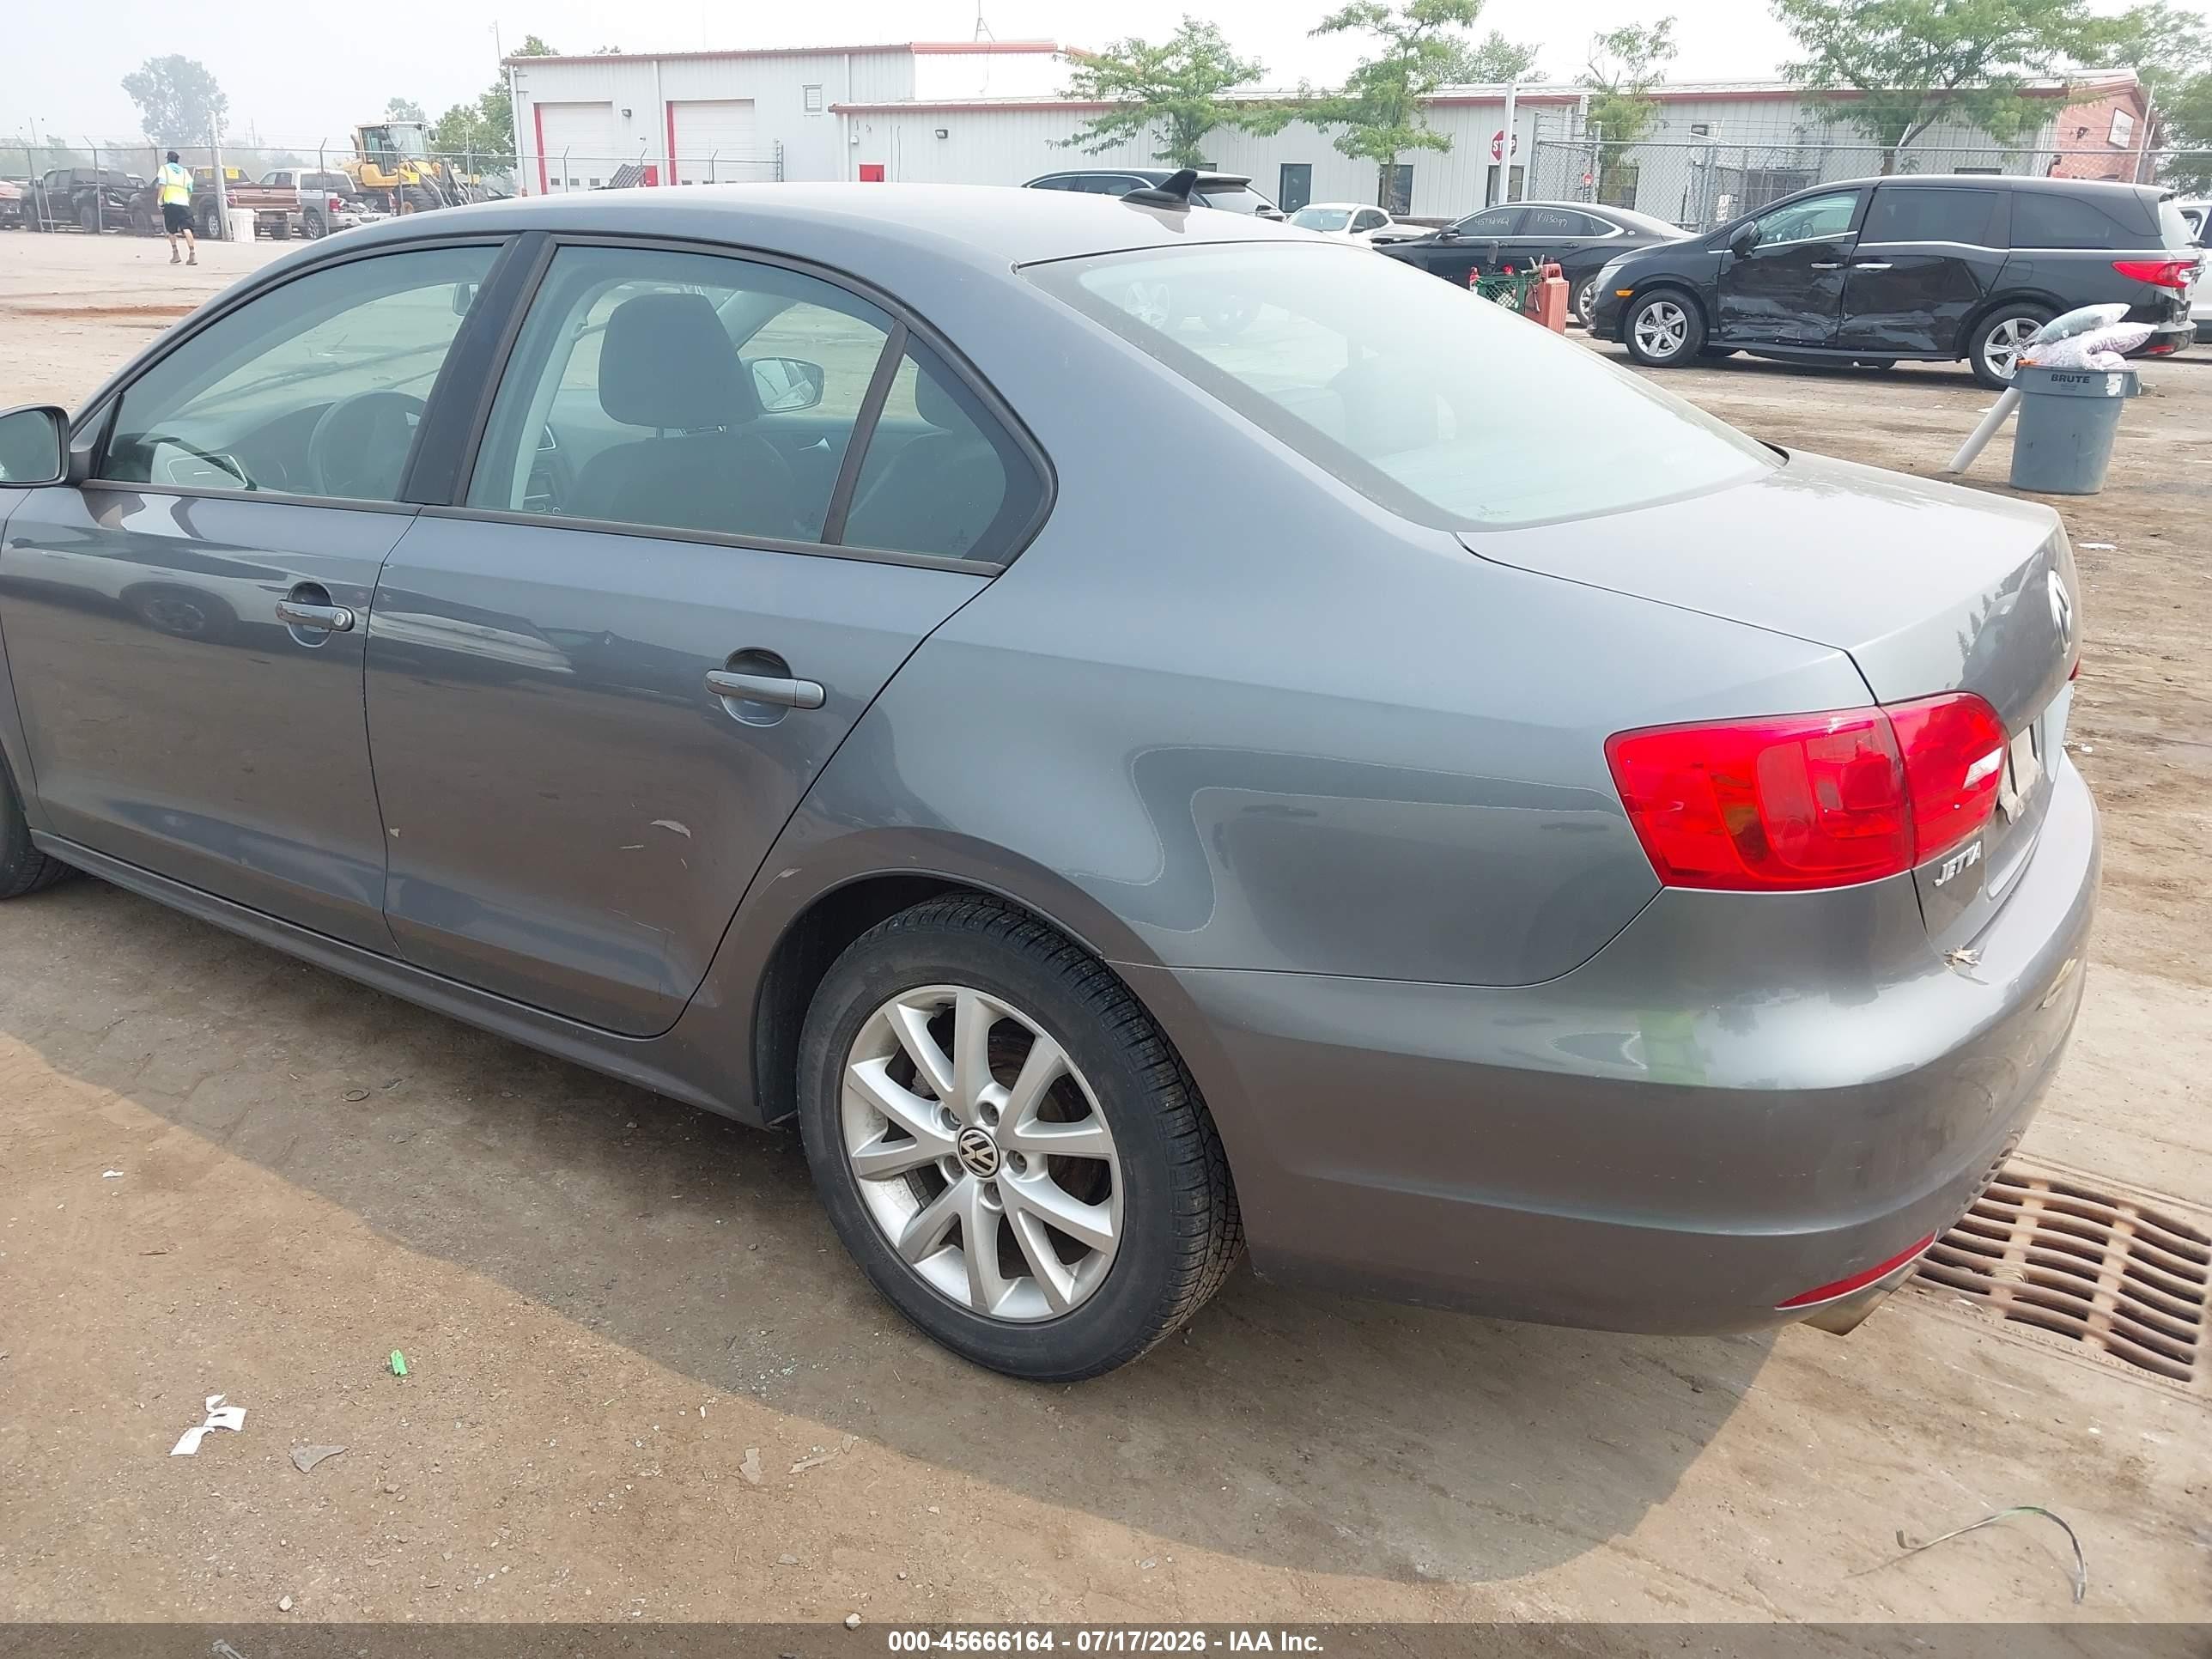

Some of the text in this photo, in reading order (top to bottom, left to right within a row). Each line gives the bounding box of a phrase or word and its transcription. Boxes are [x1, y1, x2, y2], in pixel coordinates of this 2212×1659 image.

[1492, 139, 1516, 152] STP
[2051, 374, 2091, 384] BRUTE
[1932, 840, 1982, 887] JETTA
